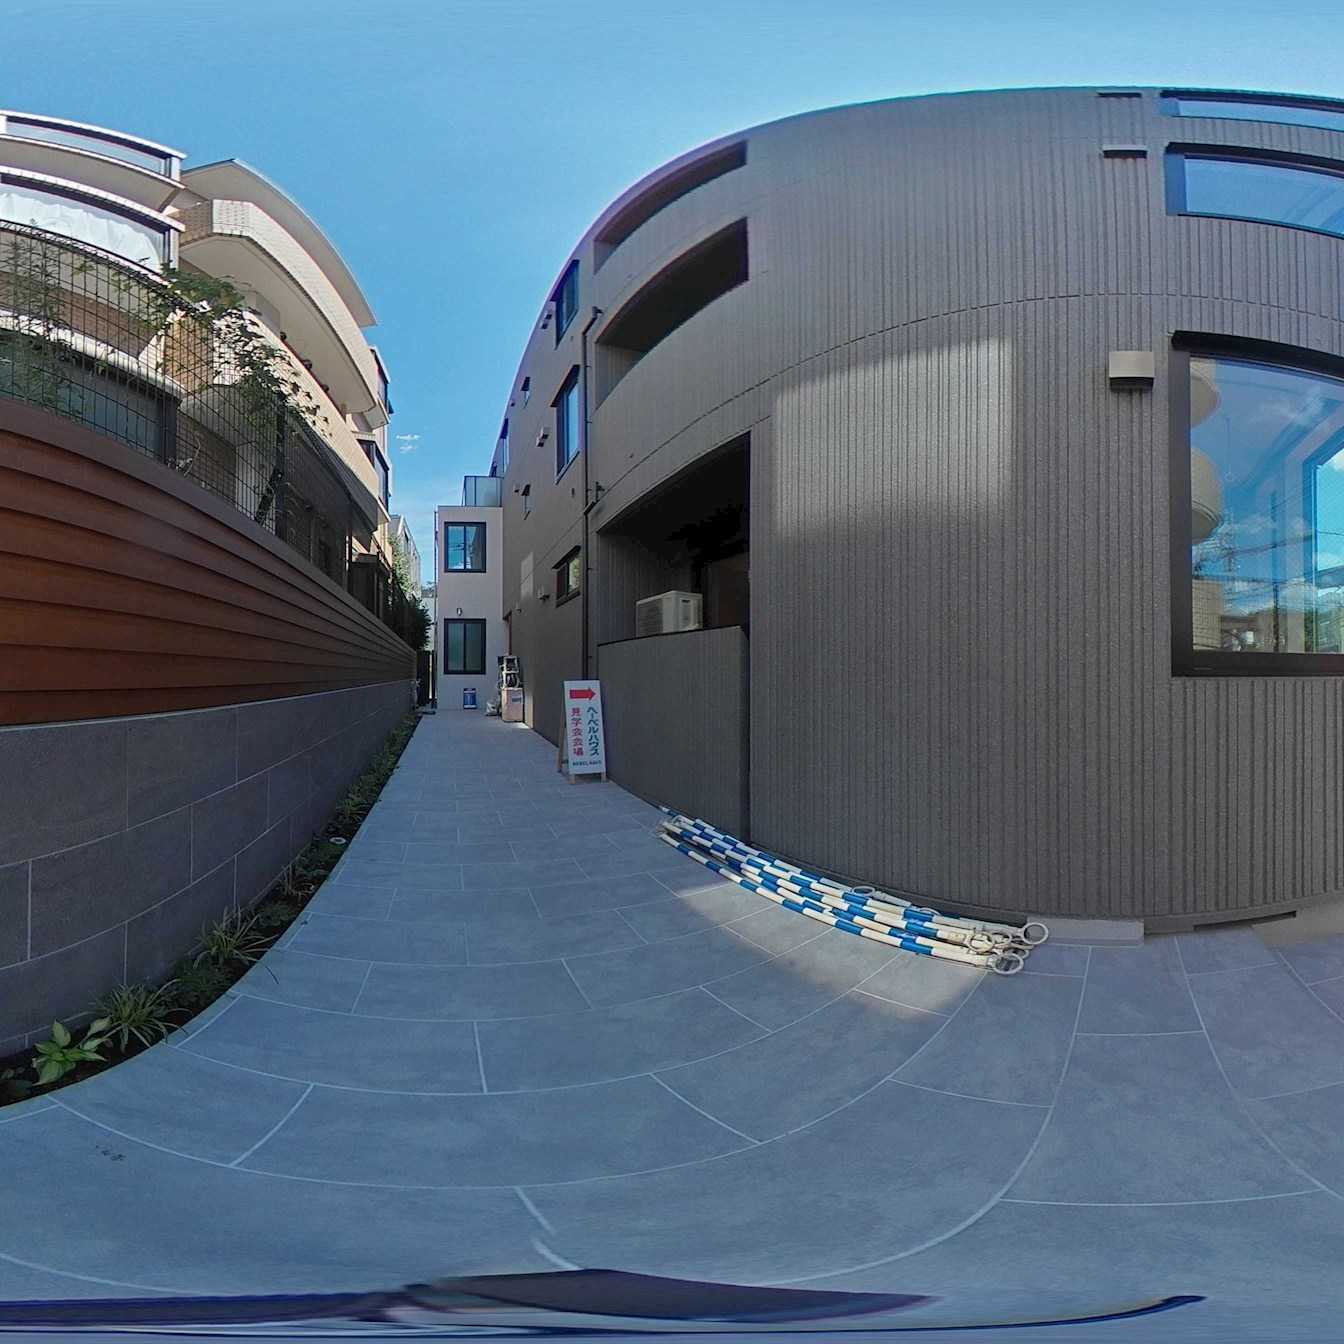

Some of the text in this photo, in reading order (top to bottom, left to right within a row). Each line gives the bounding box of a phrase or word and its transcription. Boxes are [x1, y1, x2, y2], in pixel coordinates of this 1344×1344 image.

[571, 707, 584, 756] 見学会会場
[587, 706, 600, 757] ヘーベルハウス
